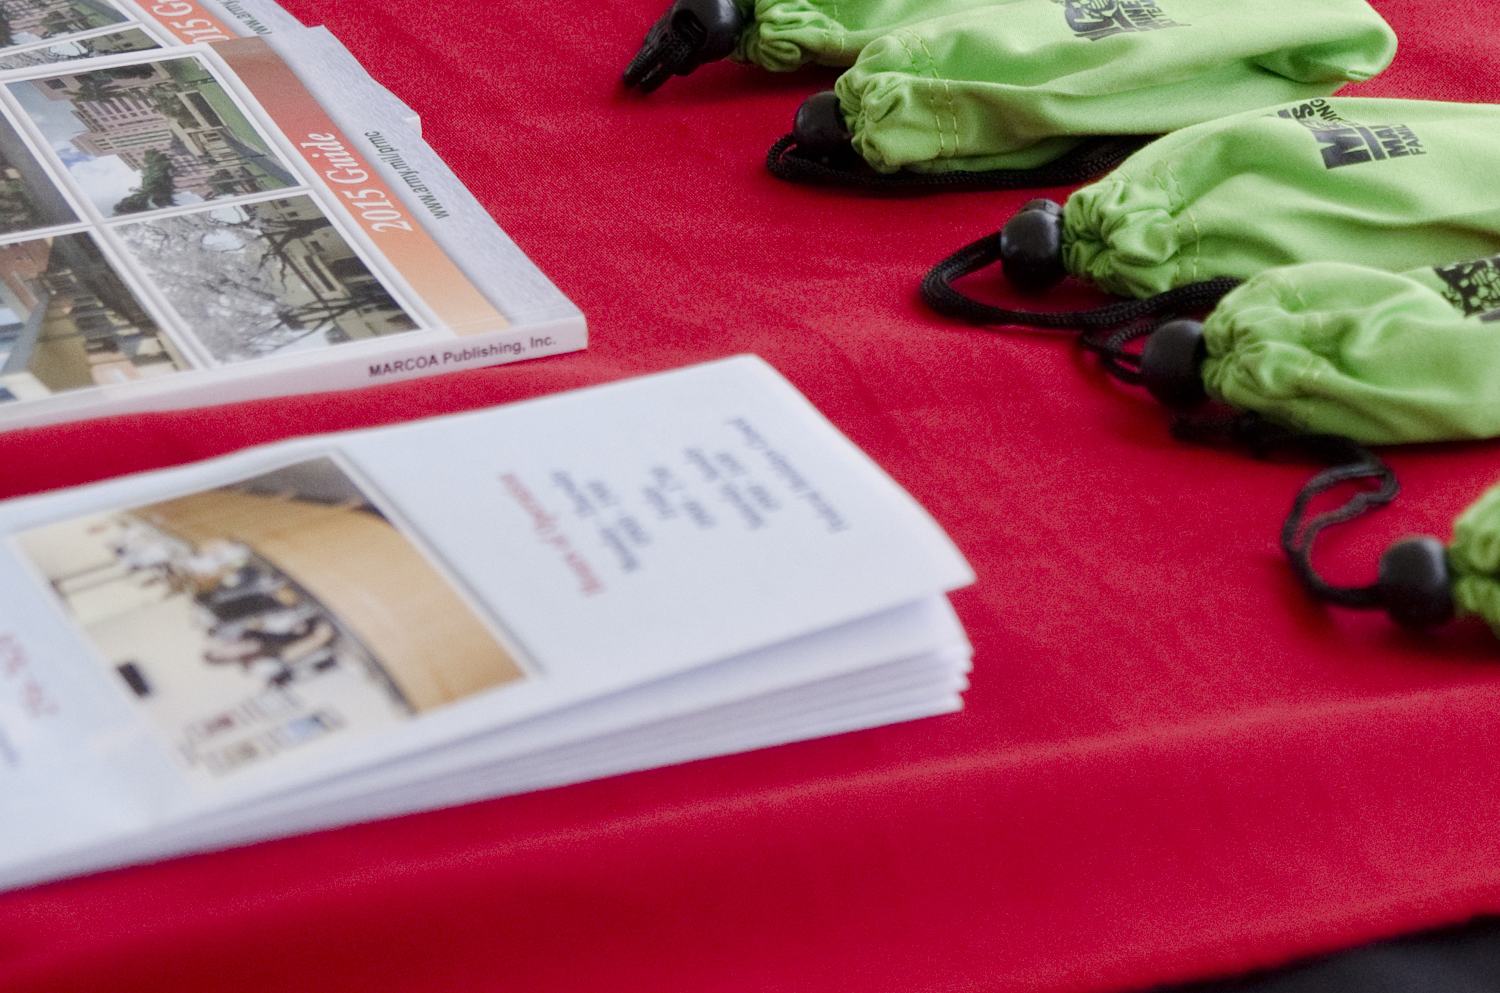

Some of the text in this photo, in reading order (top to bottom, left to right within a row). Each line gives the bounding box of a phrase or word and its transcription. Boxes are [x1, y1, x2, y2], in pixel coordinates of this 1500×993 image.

[169, 18, 230, 43] 015
[300, 132, 413, 232] 2015 Guide
[364, 131, 450, 219] www.army.mil/prmc
[368, 334, 557, 378] MARCOA Publishing, Inc.
